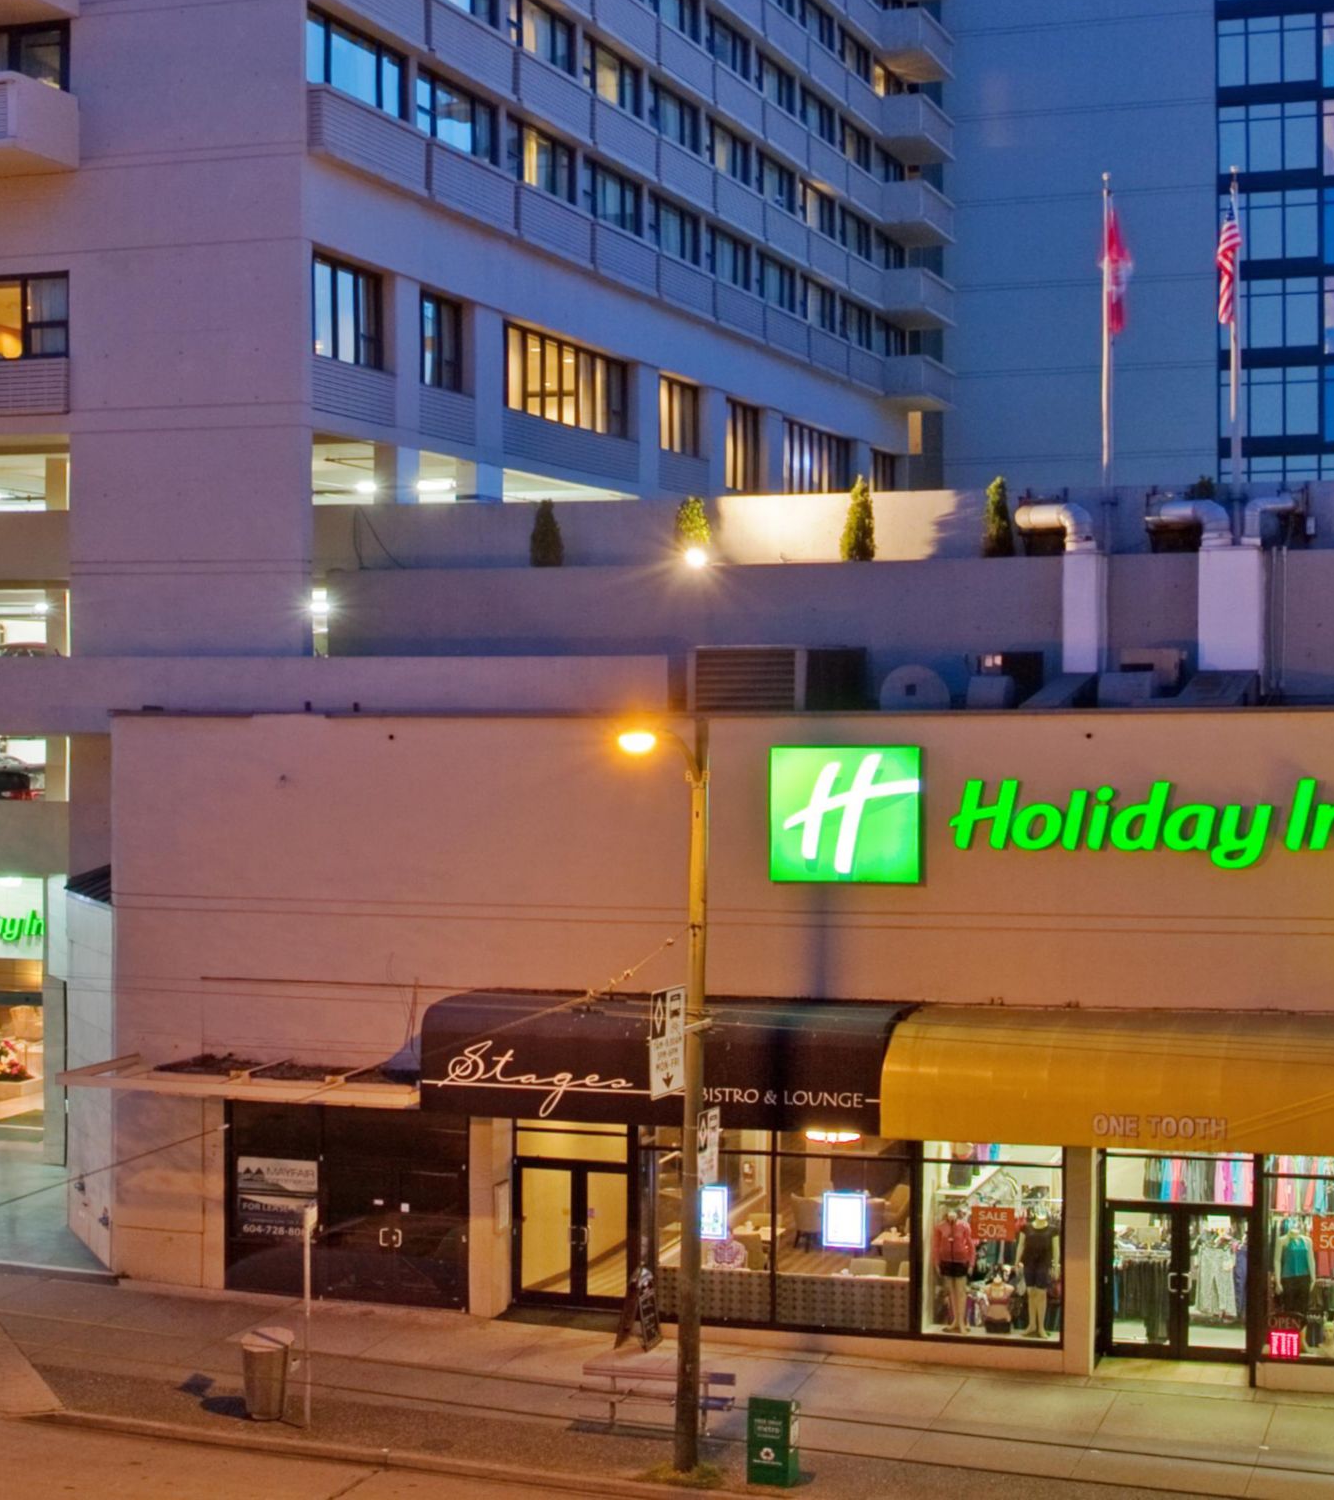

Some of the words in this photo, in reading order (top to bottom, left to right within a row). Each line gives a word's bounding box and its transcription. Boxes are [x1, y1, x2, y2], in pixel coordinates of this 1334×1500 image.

[950, 779, 1272, 869] Holiday
[24, 910, 44, 936] In
[438, 1040, 633, 1117] Stages
[764, 1090, 777, 1105] &
[784, 1090, 864, 1108] LOUNGE
[1093, 1113, 1140, 1138] ONE
[1147, 1116, 1228, 1140] TOOTH
[267, 1167, 315, 1178] MAYFAIR
[242, 1202, 260, 1211] FOR
[978, 1210, 1008, 1221] SALE
[242, 1224, 314, 1237] 604-728-80
[1268, 1316, 1300, 1329] OPEN
